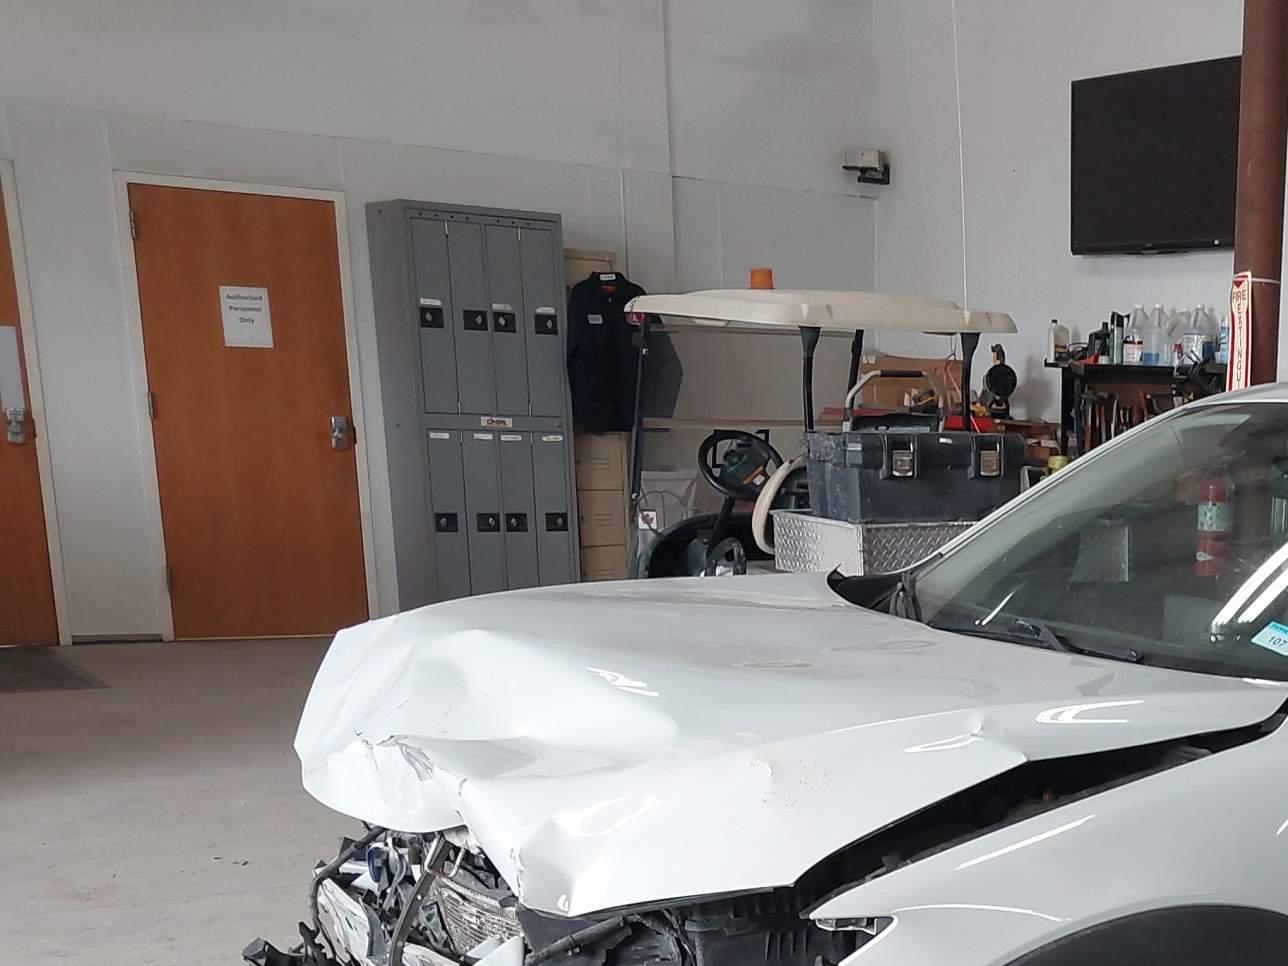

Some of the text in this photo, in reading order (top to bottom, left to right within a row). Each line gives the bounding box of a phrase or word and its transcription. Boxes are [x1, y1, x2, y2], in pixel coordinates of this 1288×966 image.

[1232, 289, 1247, 301] FIRE
[238, 316, 255, 325] Only
[1268, 635, 1288, 647] 107
